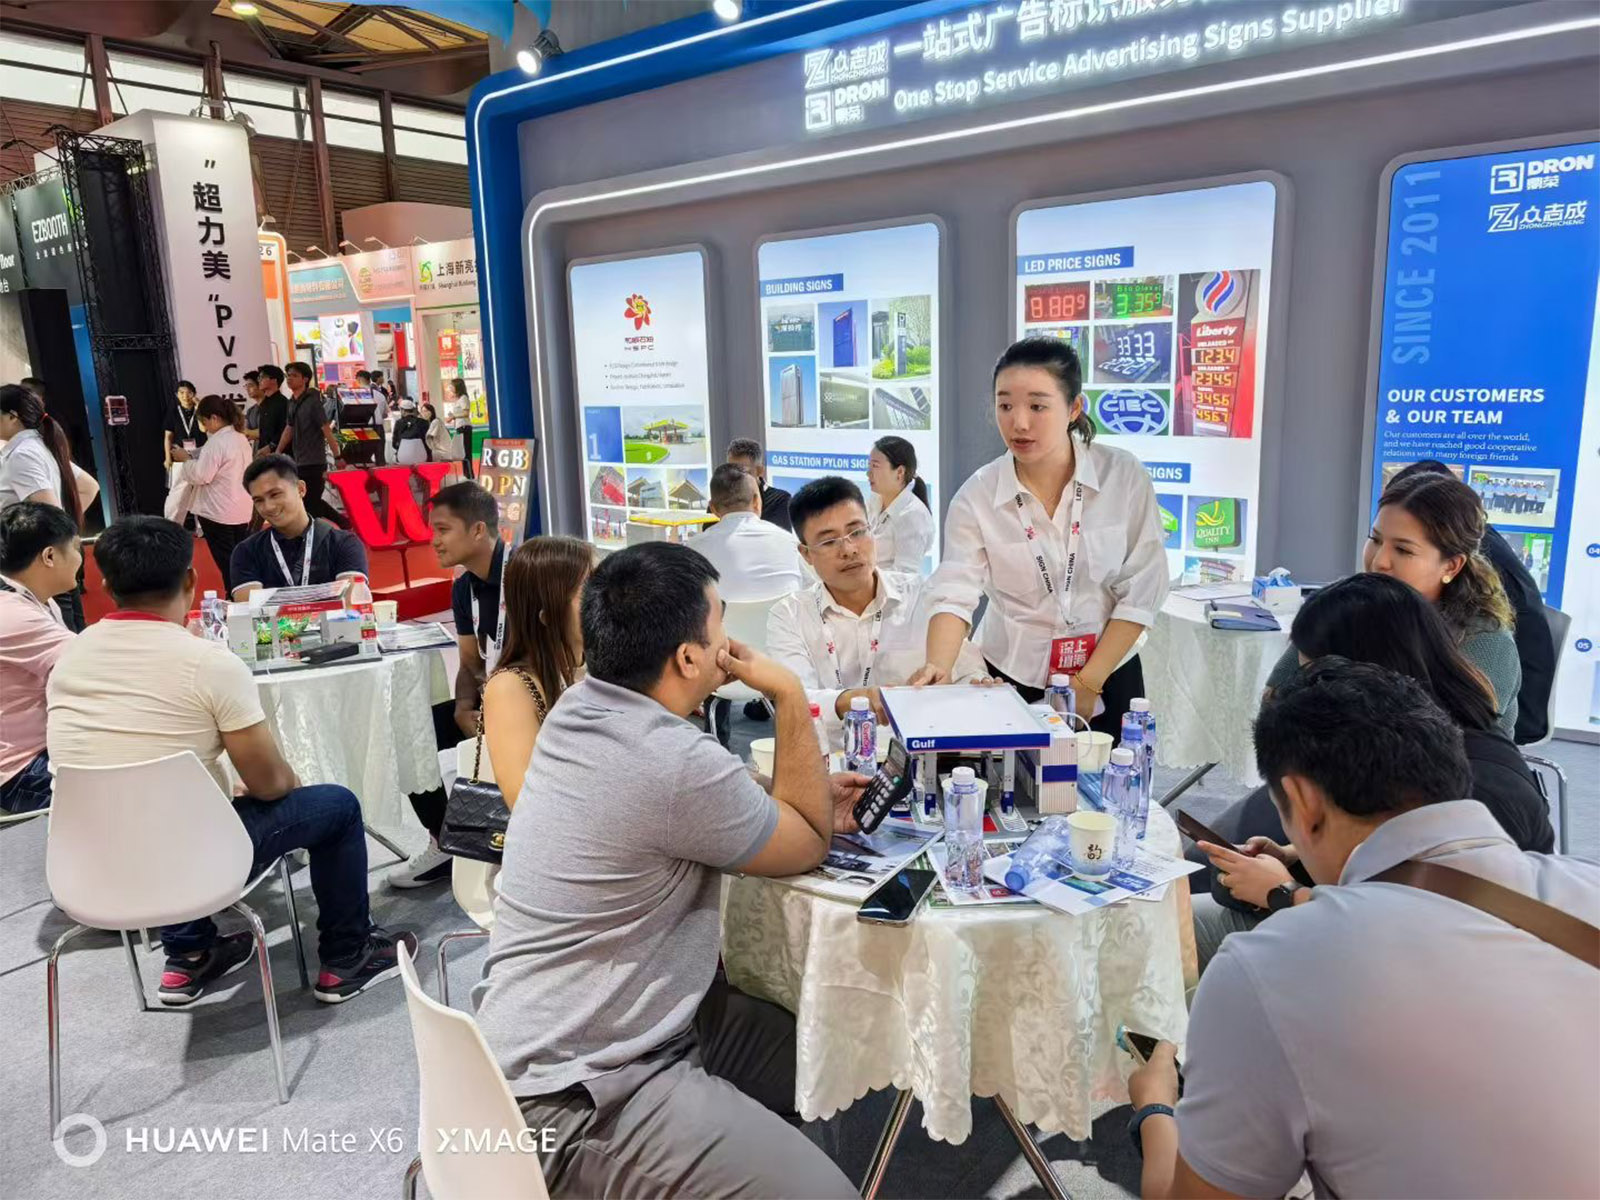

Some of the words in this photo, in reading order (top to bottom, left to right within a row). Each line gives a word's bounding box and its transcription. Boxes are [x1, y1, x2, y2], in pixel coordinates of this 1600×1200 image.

[894, 89, 930, 110] One
[935, 77, 980, 102] Stop
[984, 61, 1059, 92] Service
[1062, 32, 1200, 76] Advertising
[1203, 18, 1275, 50] Signs
[1281, 0, 1402, 33] Supplier
[835, 78, 889, 107] DRON
[1527, 154, 1595, 176] DRON
[1401, 171, 1440, 255] 2011
[1520, 201, 1588, 223] 众志成
[32, 212, 69, 243] EZBOOTH
[437, 259, 478, 277] 上海新亮
[1025, 259, 1045, 273] LED
[1048, 256, 1081, 271] PRICE
[1084, 253, 1121, 268] SIGNS
[765, 281, 804, 295] BUILDING
[806, 279, 833, 292] SIGNS
[1391, 269, 1436, 364] SINCE
[1196, 325, 1238, 337] Liberty
[1387, 389, 1425, 402] OUR
[1430, 388, 1545, 403] CUSTOMERS
[1102, 399, 1161, 413] CIEC
[1385, 409, 1400, 423] &
[1407, 410, 1447, 423] OUR
[1451, 410, 1503, 424] TEAM
[1384, 430, 1400, 438] Our
[1402, 431, 1441, 439] customers
[1488, 432, 1502, 440] the
[589, 433, 602, 459] 1
[1464, 441, 1486, 451] good
[1487, 444, 1537, 452] cooperative
[772, 455, 788, 465] GAS
[789, 456, 820, 467] STATION
[823, 457, 849, 469] PYLON
[1435, 452, 1458, 460] many
[1459, 451, 1488, 461] foreign
[1490, 453, 1519, 461] friends
[1196, 525, 1231, 538] QUALITY
[1036, 555, 1047, 571] SIGN
[911, 739, 936, 749] Gulf
